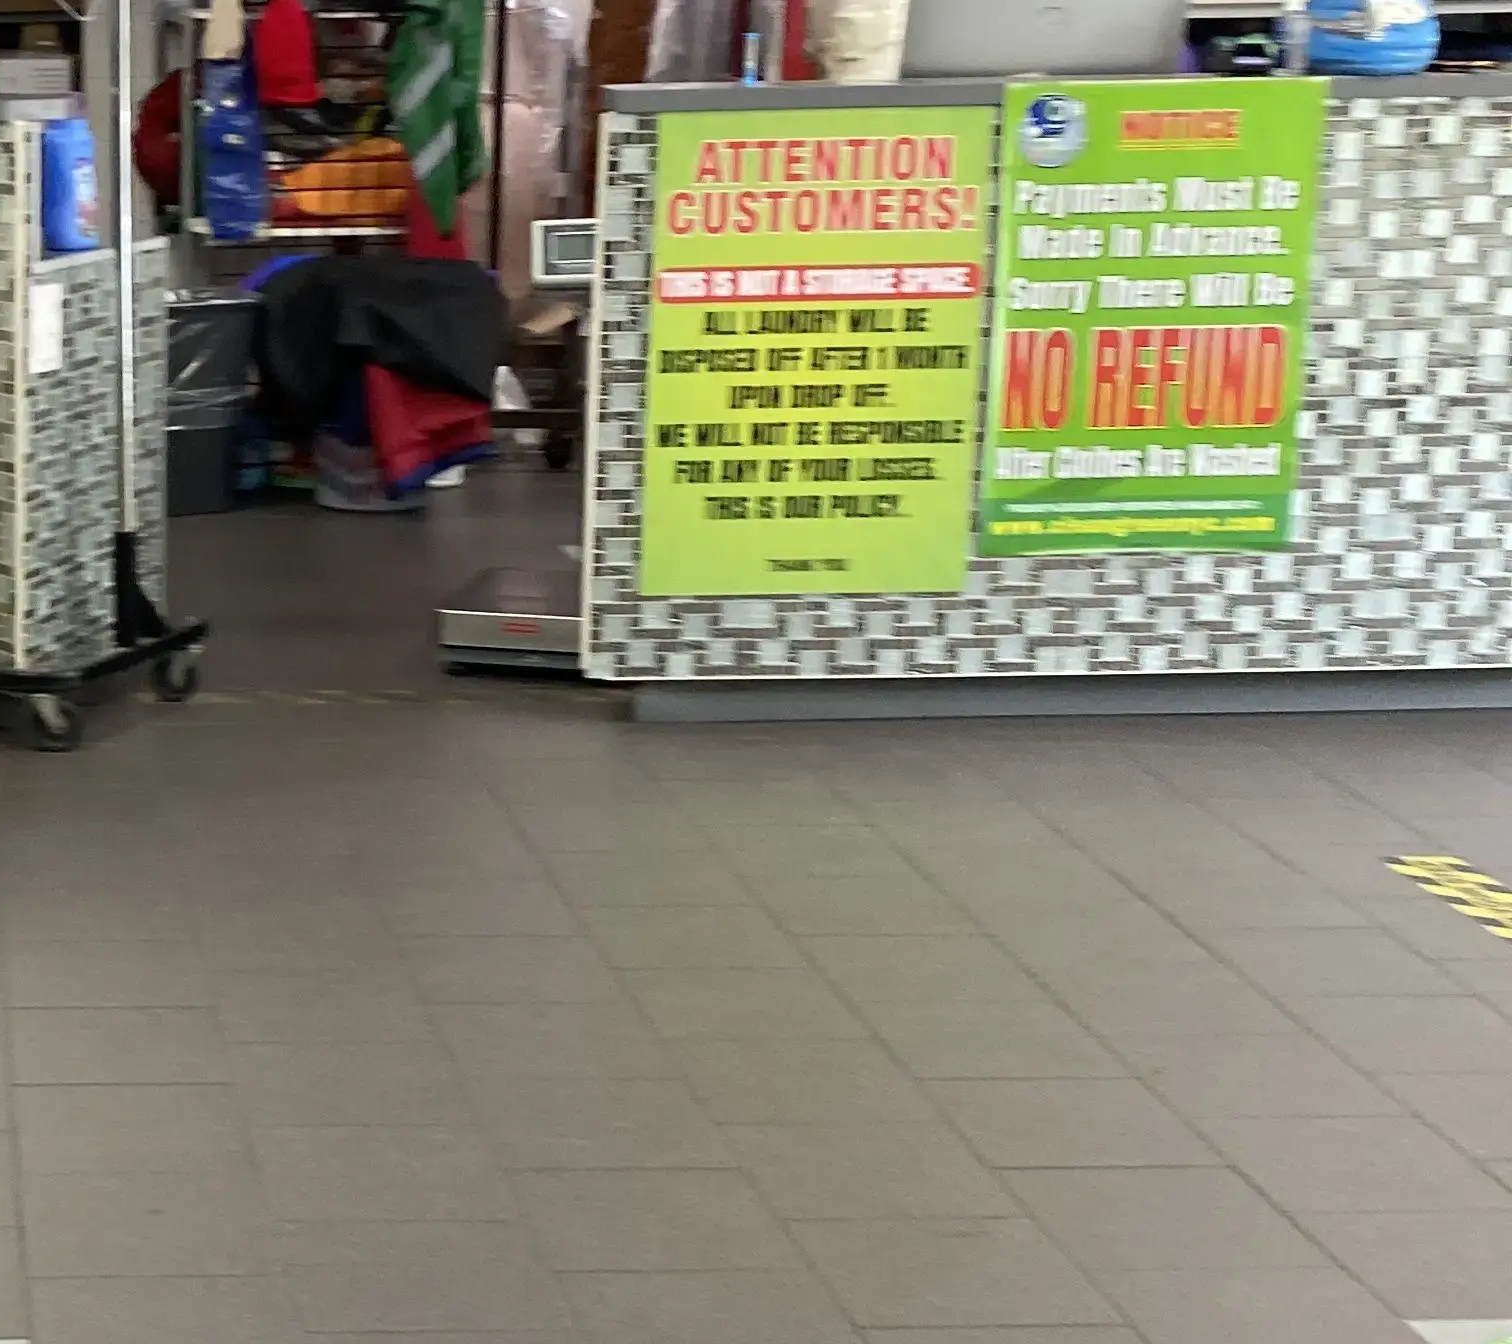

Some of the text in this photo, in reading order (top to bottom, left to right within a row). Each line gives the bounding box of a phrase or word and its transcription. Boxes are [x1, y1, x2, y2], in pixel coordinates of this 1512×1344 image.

[691, 135, 957, 185] ATTENTION
[667, 186, 979, 235] CUSTOMERS!
[1014, 175, 1301, 219] Payments Must Be
[1018, 222, 1290, 260] Made In Advance.
[1009, 272, 1295, 314] Sorry There Will Be
[701, 307, 931, 335] ALL LAUNDRY WILL BE
[657, 348, 757, 373] DISPOSED
[765, 347, 806, 371] OFF
[808, 346, 869, 370] AFTER
[893, 345, 970, 369] MONTH
[999, 324, 1288, 431] NO REFUND
[726, 384, 781, 409] UPON
[788, 384, 844, 408] DROP
[654, 420, 966, 447] WE WILL NOT BE RESPONSIBLE
[673, 459, 714, 483] FOR
[718, 459, 760, 483] ANY
[764, 459, 794, 482] OF
[797, 458, 851, 481] YOUR
[701, 496, 751, 520] THIS
[753, 496, 777, 519] IS
[781, 495, 824, 519] OUR
